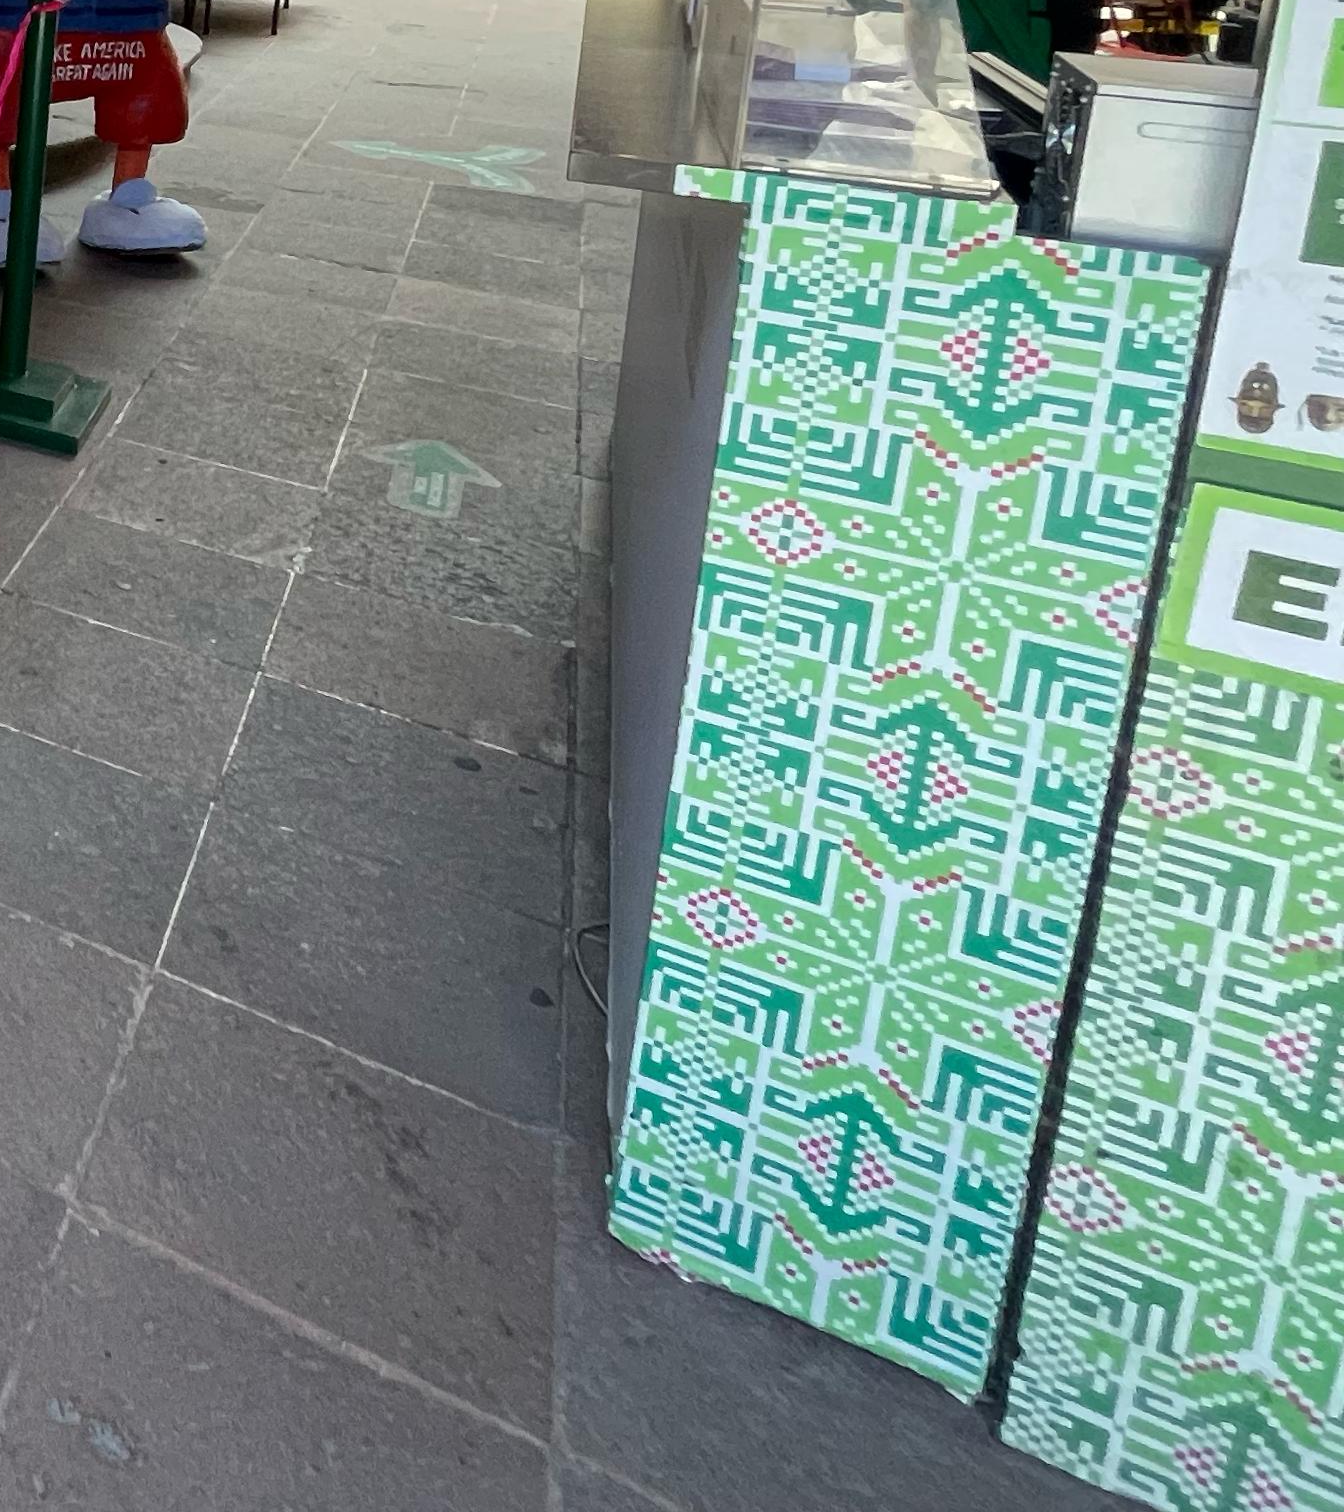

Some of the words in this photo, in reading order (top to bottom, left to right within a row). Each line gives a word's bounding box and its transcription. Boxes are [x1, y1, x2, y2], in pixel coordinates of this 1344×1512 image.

[53, 43, 72, 63] KE
[81, 41, 146, 59] AMERICA
[52, 64, 92, 82] REAT
[92, 63, 134, 80] AGAIN
[1232, 549, 1344, 647] E
